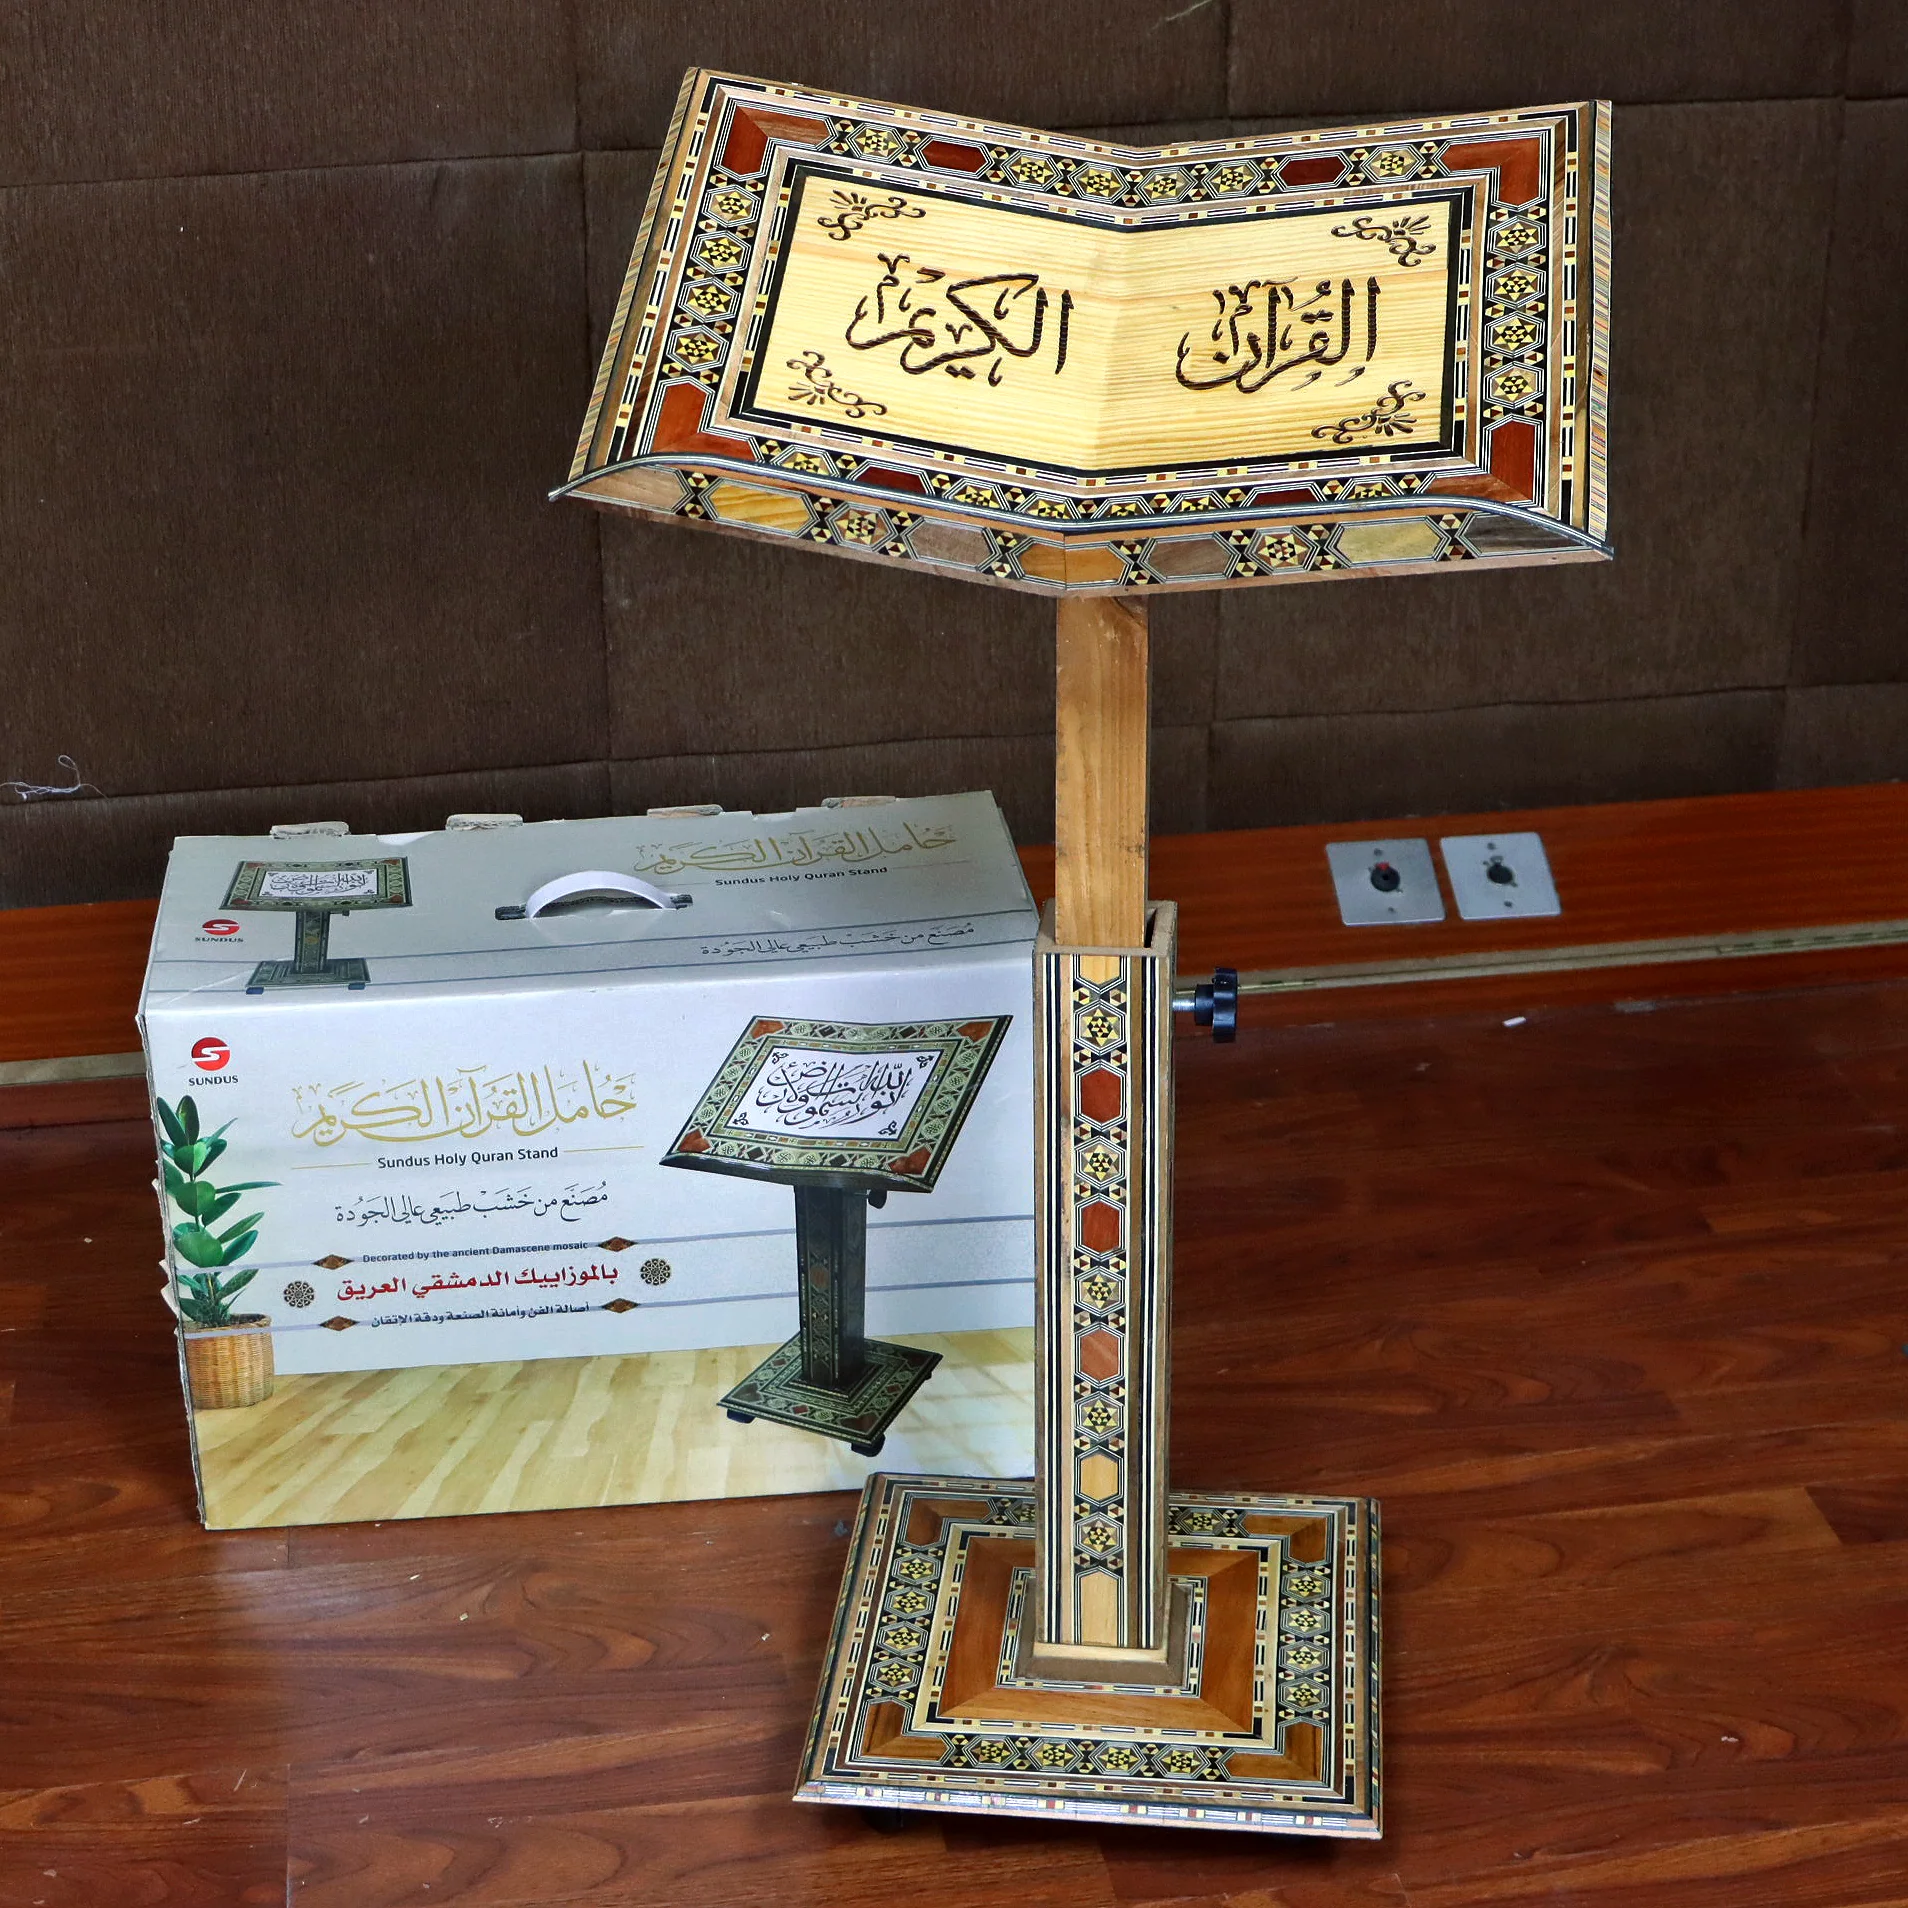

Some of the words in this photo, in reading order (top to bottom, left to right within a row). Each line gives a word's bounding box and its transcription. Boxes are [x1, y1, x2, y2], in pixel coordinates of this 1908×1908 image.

[845, 252, 1074, 387] الكريم
[633, 837, 781, 875] الكريم
[715, 877, 766, 886] Sundus
[770, 873, 800, 885] Holy
[805, 870, 845, 880] Quran
[849, 866, 888, 876] Stand
[901, 932, 924, 945] من
[188, 1075, 239, 1086] SUNDUS
[291, 1078, 449, 1146] الكريم
[378, 1156, 431, 1169] Sundus
[434, 1153, 466, 1167] Holy
[471, 1150, 514, 1165] Quran
[518, 1147, 558, 1160] Stand
[334, 1195, 397, 1228] الجودة
[421, 1191, 471, 1226] طبيعي
[534, 1197, 558, 1217] من
[362, 1252, 414, 1264] Decorated
[417, 1250, 430, 1262] by
[433, 1248, 449, 1259] the
[452, 1246, 489, 1258] ancient
[492, 1243, 550, 1255] Damascene
[553, 1240, 588, 1251] mosaic
[412, 1270, 509, 1299] الدمشقي
[514, 1264, 619, 1289] بالموزاييك
[337, 1276, 406, 1301] العريق
[446, 1308, 490, 1321] الصنعة
[491, 1307, 525, 1320] وأمانة
[528, 1304, 553, 1318] الفن
[555, 1301, 590, 1313] أصالة
[371, 1314, 413, 1329] الإتقان
[414, 1311, 444, 1325] ودقة
